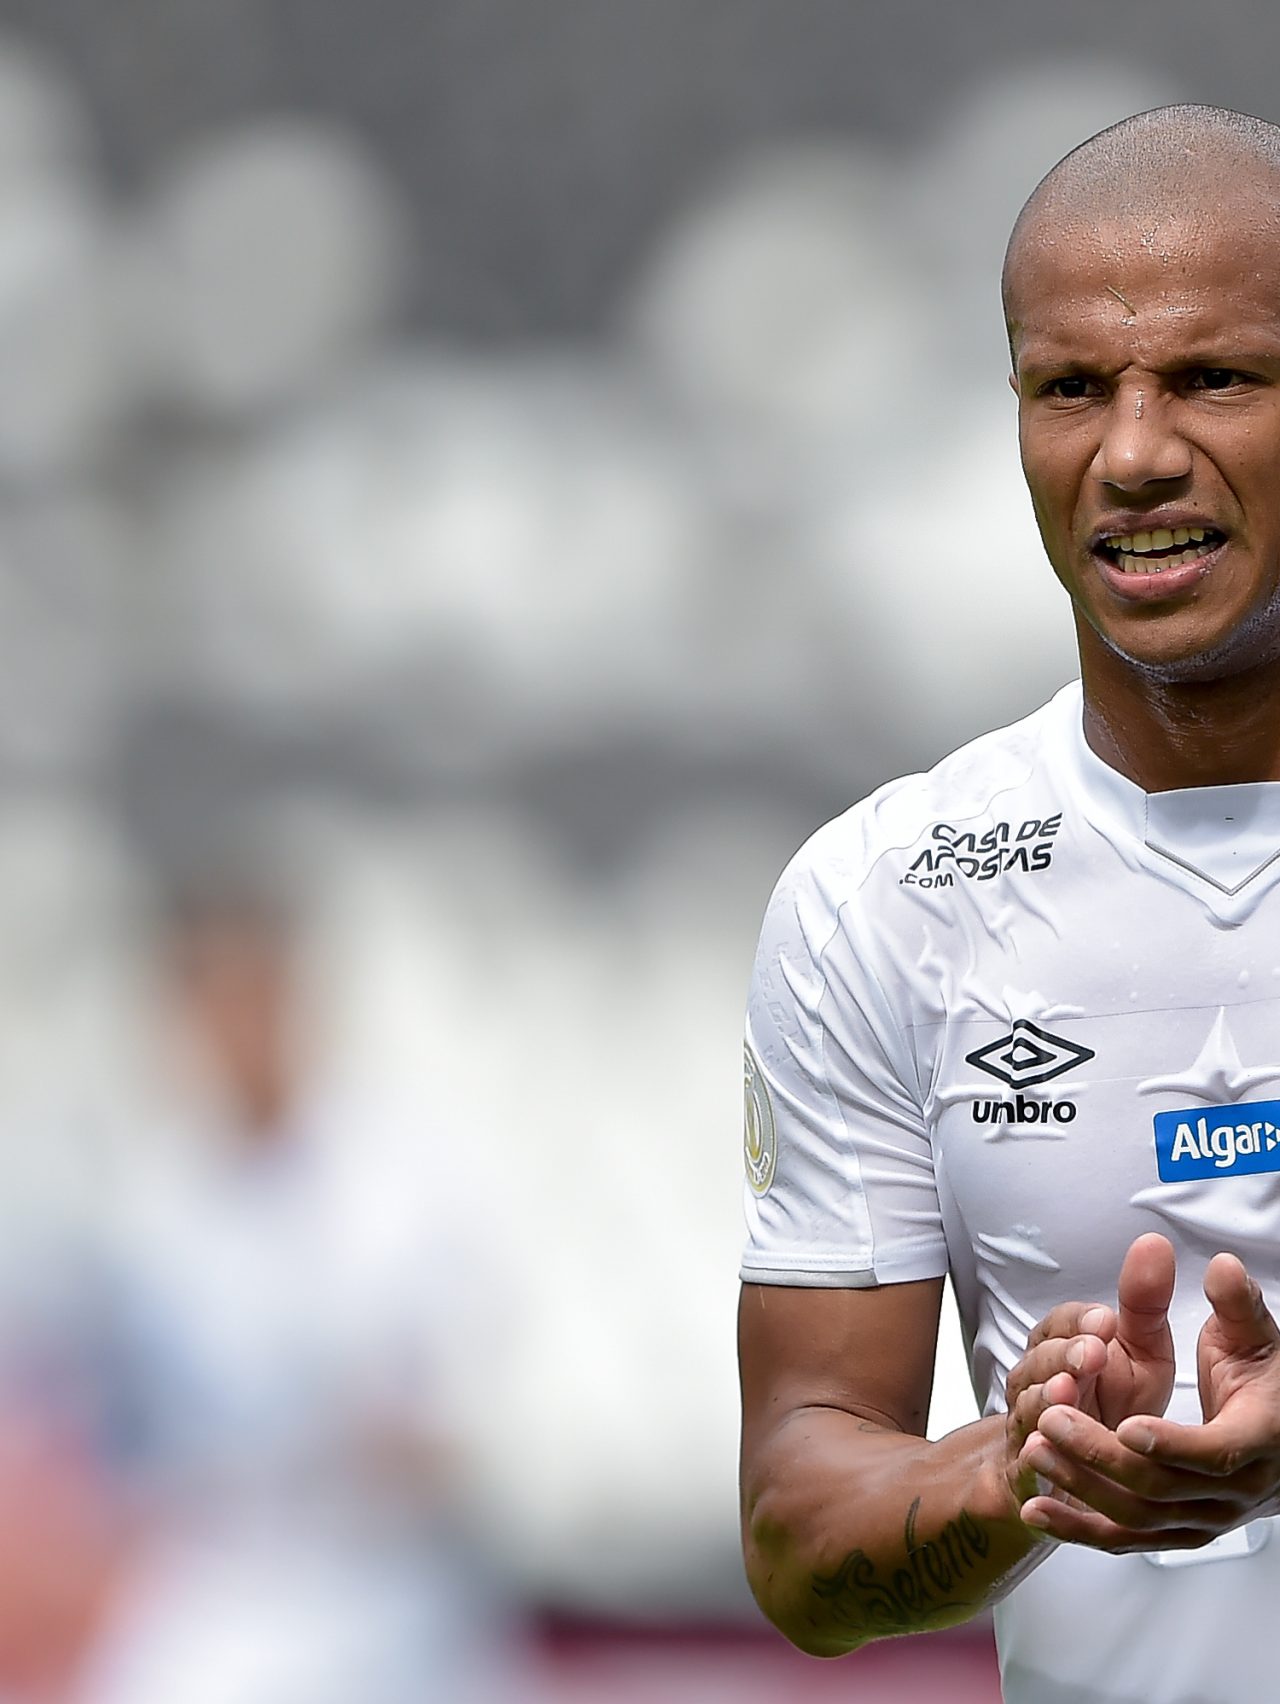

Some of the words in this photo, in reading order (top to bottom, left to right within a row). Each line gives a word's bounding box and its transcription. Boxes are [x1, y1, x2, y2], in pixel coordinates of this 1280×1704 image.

[1015, 812, 1062, 842] DE
[899, 873, 954, 888] .COM
[1171, 1117, 1263, 1168] Algar
